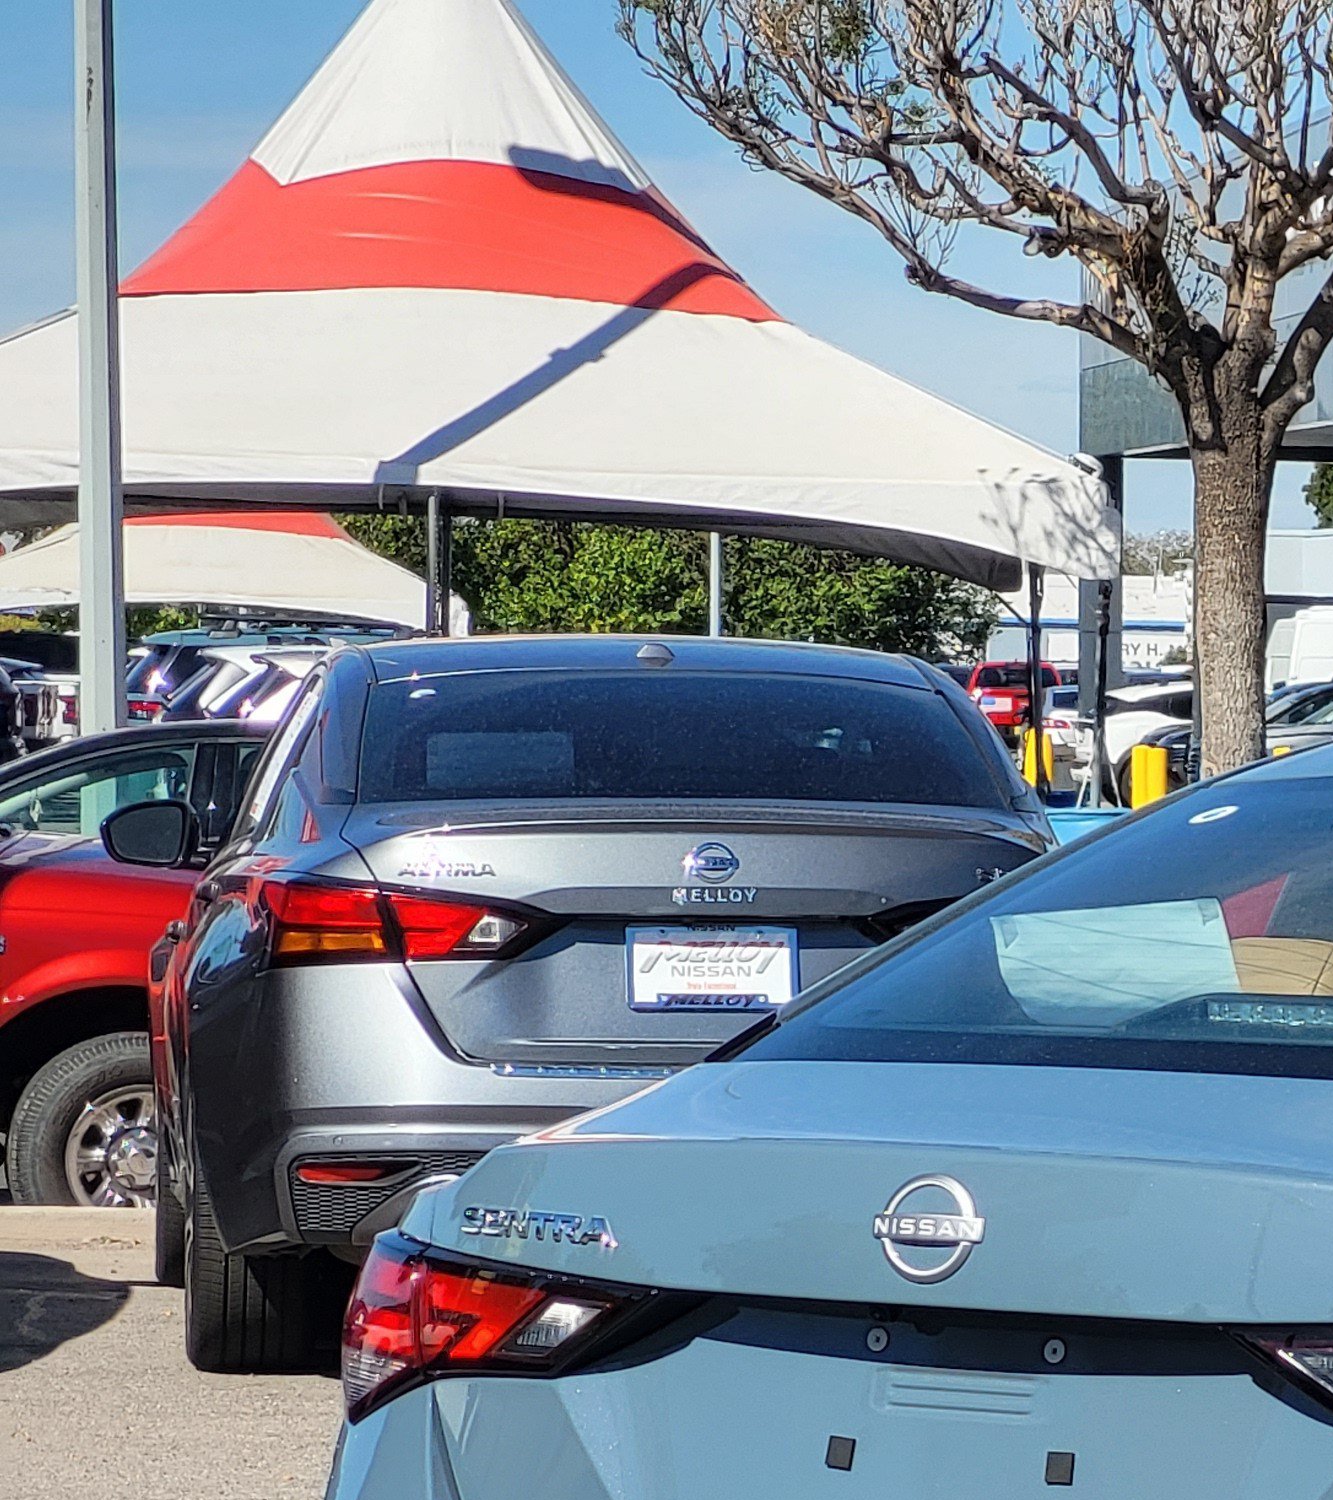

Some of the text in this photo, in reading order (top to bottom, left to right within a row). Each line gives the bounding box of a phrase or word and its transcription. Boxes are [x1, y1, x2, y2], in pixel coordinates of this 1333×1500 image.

[672, 887, 757, 903] MELLOY
[671, 965, 752, 977] NISSAN
[460, 1206, 619, 1249] SENTRA
[873, 1216, 982, 1239] NISSAN
